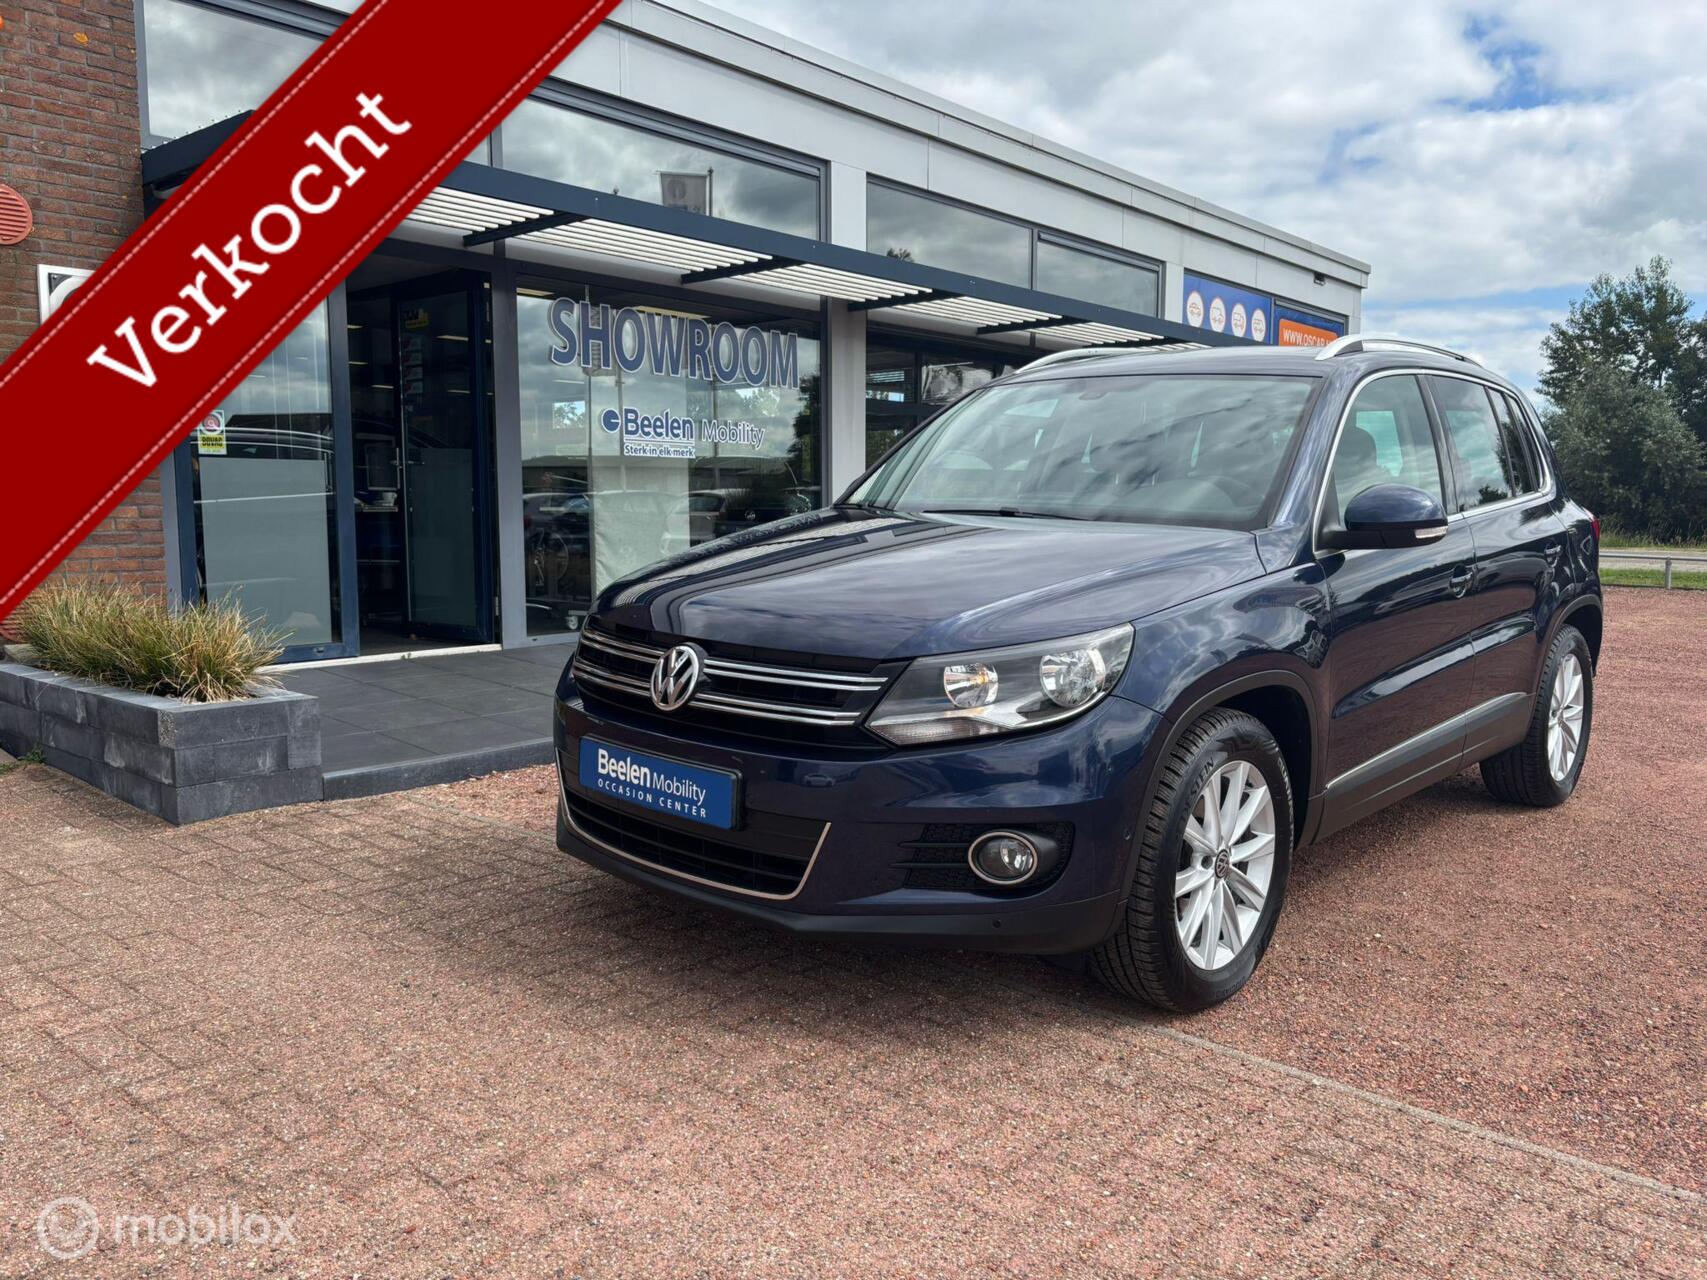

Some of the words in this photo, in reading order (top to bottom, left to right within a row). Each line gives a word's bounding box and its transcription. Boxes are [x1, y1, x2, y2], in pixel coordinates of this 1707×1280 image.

[550, 297, 799, 389] SHOWROOM
[624, 407, 694, 440] Beelen
[702, 419, 765, 449] Mobility
[625, 445, 647, 455] Sterk
[649, 447, 658, 455] in
[659, 447, 672, 456] elk
[673, 449, 694, 457] merk
[598, 748, 650, 788] Beelen
[652, 772, 706, 806] Mobility
[598, 778, 652, 803] OCCASION
[659, 797, 706, 818] CENTER
